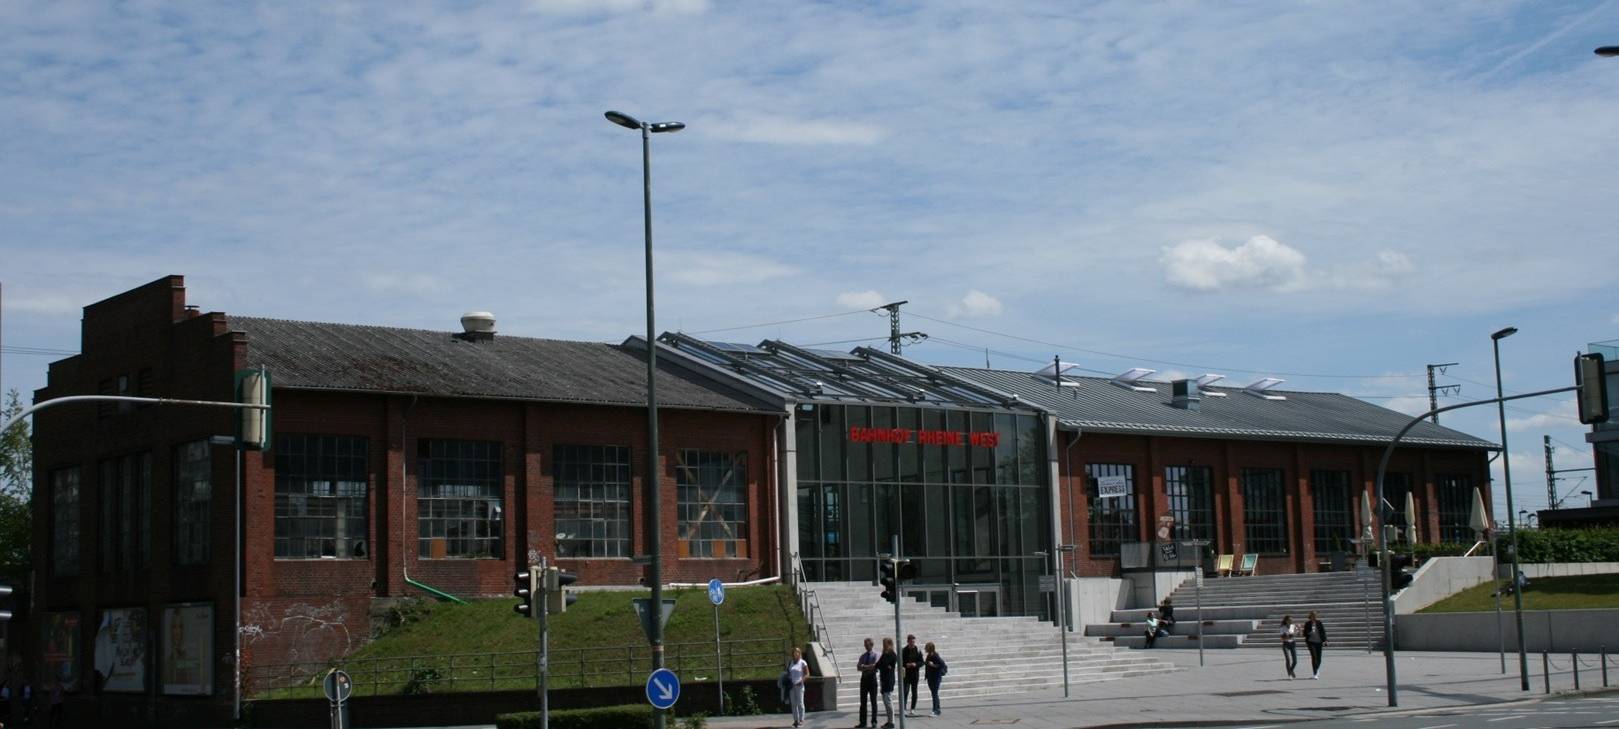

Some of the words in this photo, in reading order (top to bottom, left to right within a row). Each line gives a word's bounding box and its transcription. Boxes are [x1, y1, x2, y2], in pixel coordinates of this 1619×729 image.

[850, 427, 911, 443] BAHNHOF
[918, 430, 963, 446] RHEINE
[969, 432, 999, 447] WEST
[1101, 485, 1124, 495] EXPRESS
